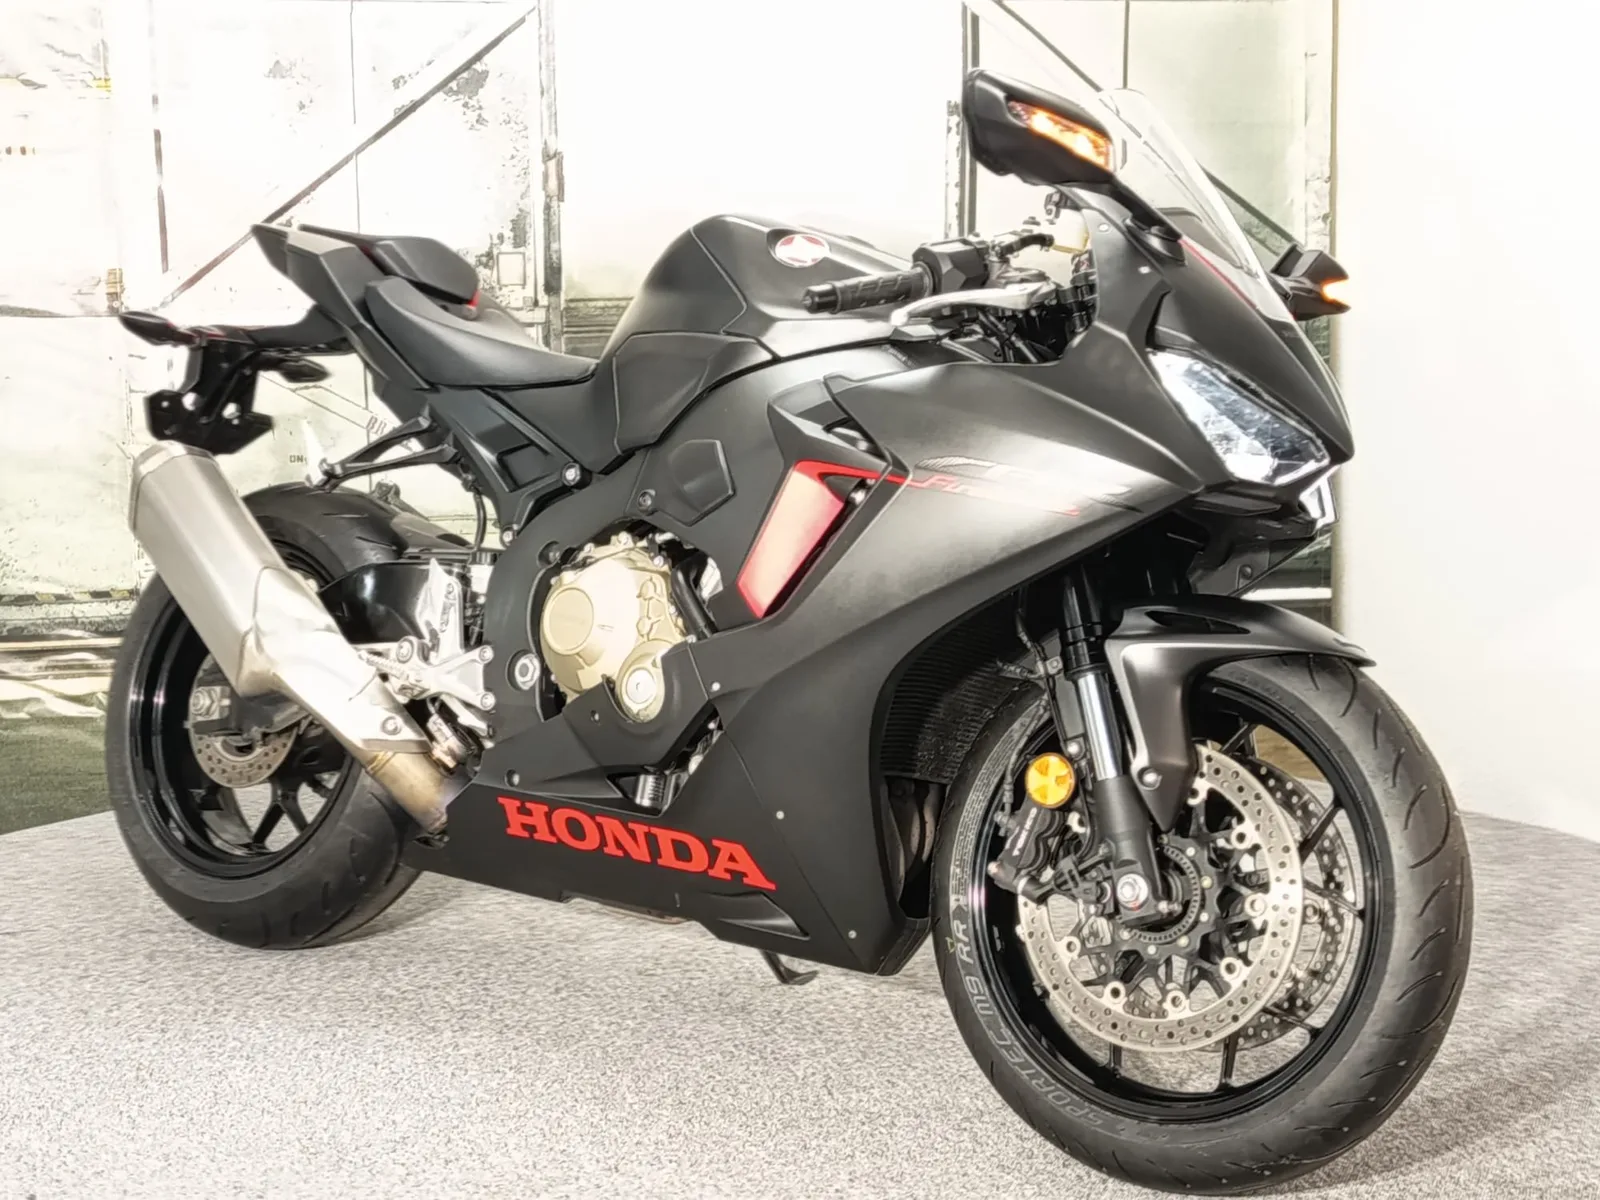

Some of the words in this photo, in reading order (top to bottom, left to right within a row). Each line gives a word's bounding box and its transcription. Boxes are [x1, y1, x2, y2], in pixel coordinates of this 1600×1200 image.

[497, 797, 776, 890] HONDA
[954, 921, 974, 965] RR
[988, 1026, 1104, 1126] SPORTEC
